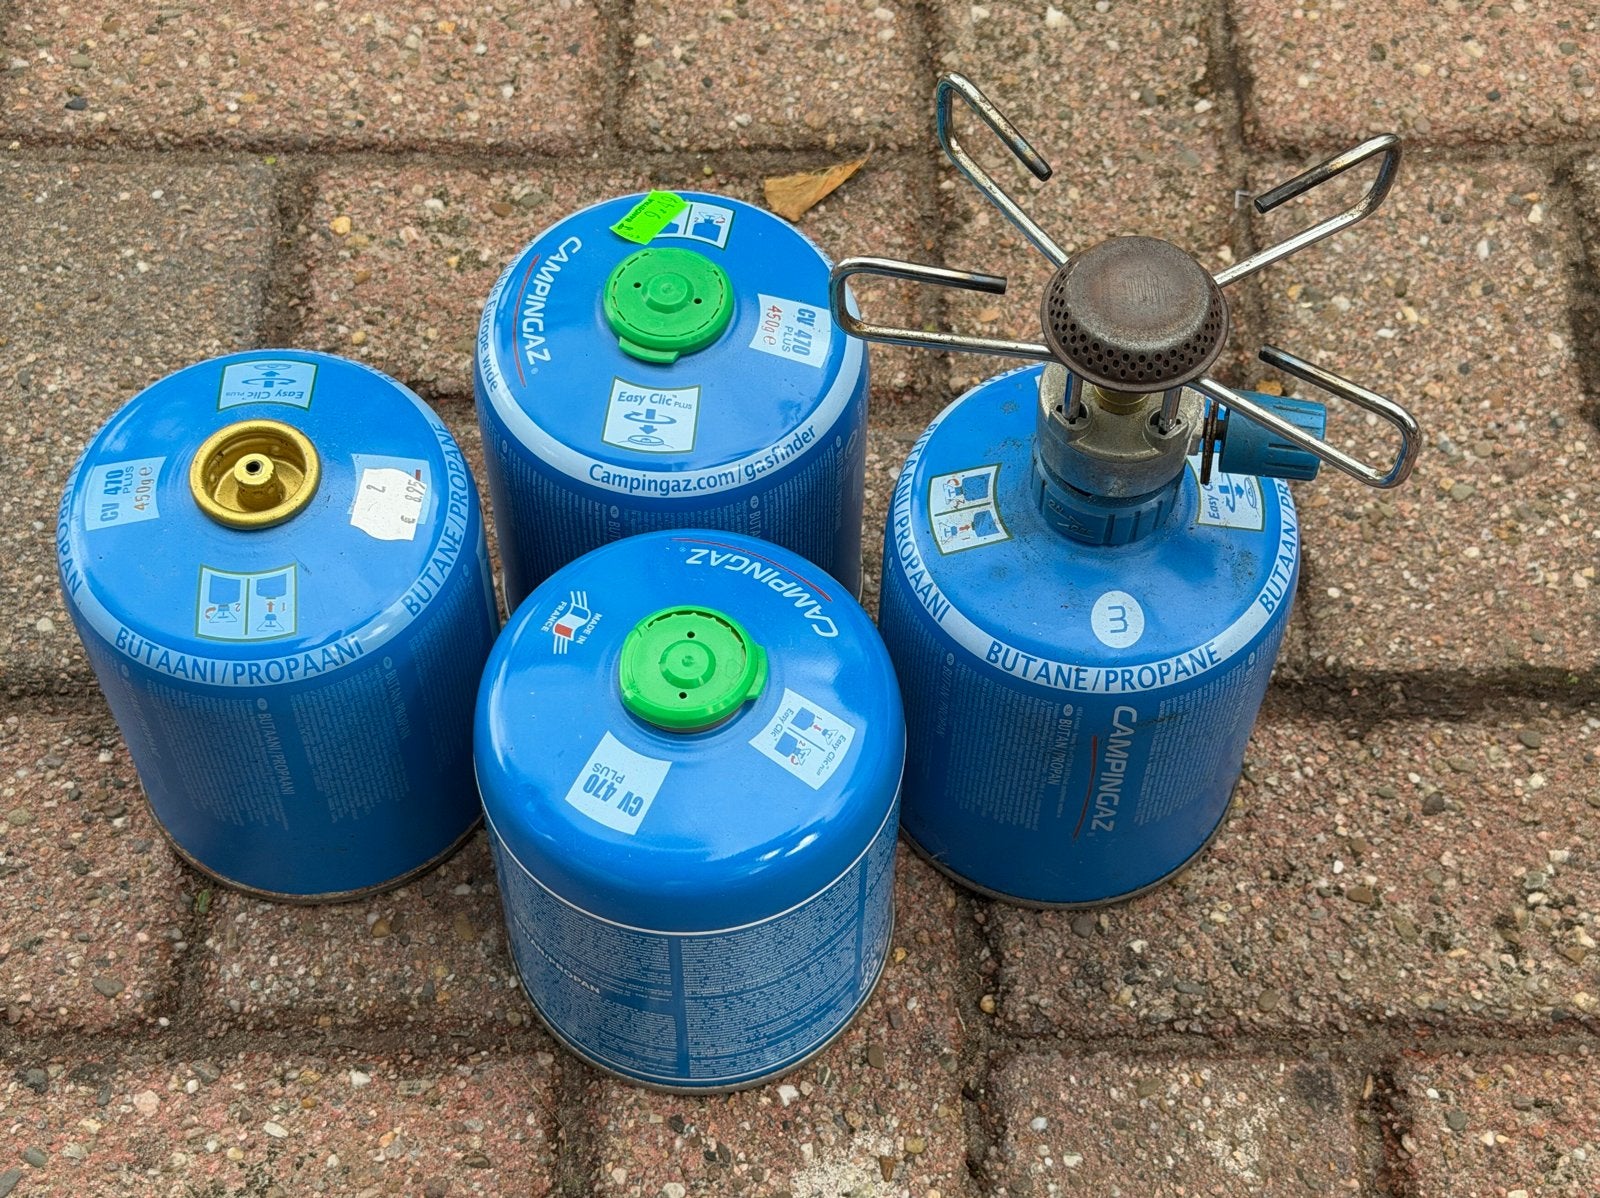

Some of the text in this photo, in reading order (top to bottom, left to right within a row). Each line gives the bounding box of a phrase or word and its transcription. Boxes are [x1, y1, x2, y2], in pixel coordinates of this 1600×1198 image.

[522, 236, 582, 365] CAMPINGAZ
[478, 301, 497, 350] Europe
[781, 325, 794, 353] PLUS
[791, 308, 816, 356] CV 470
[482, 354, 499, 393] wide
[247, 389, 304, 400] Easy Clic
[617, 391, 673, 406] Easy Clic
[673, 401, 692, 410] PLUS
[122, 465, 134, 494] PLUS
[589, 424, 816, 497] Campingaz.com/gasfinder
[100, 469, 124, 522] CV 470
[1207, 494, 1221, 520] Easy
[401, 422, 468, 618] BUTANE/PROPANE
[685, 548, 839, 638] CAMPINGAZ
[540, 600, 568, 632] FRANCE
[575, 612, 603, 645] MADE IN
[115, 626, 365, 685] BUTAANI/PROPAANI
[985, 640, 1223, 692] BUTANE/PROPANE
[770, 708, 795, 737] Easy Clic
[824, 734, 847, 766] Easy Clic
[1046, 718, 1073, 786] BUTAN/PROPAN
[1090, 705, 1138, 832] CAMPINGAZ
[592, 762, 626, 785] PLUS
[582, 773, 644, 817] CV 470
